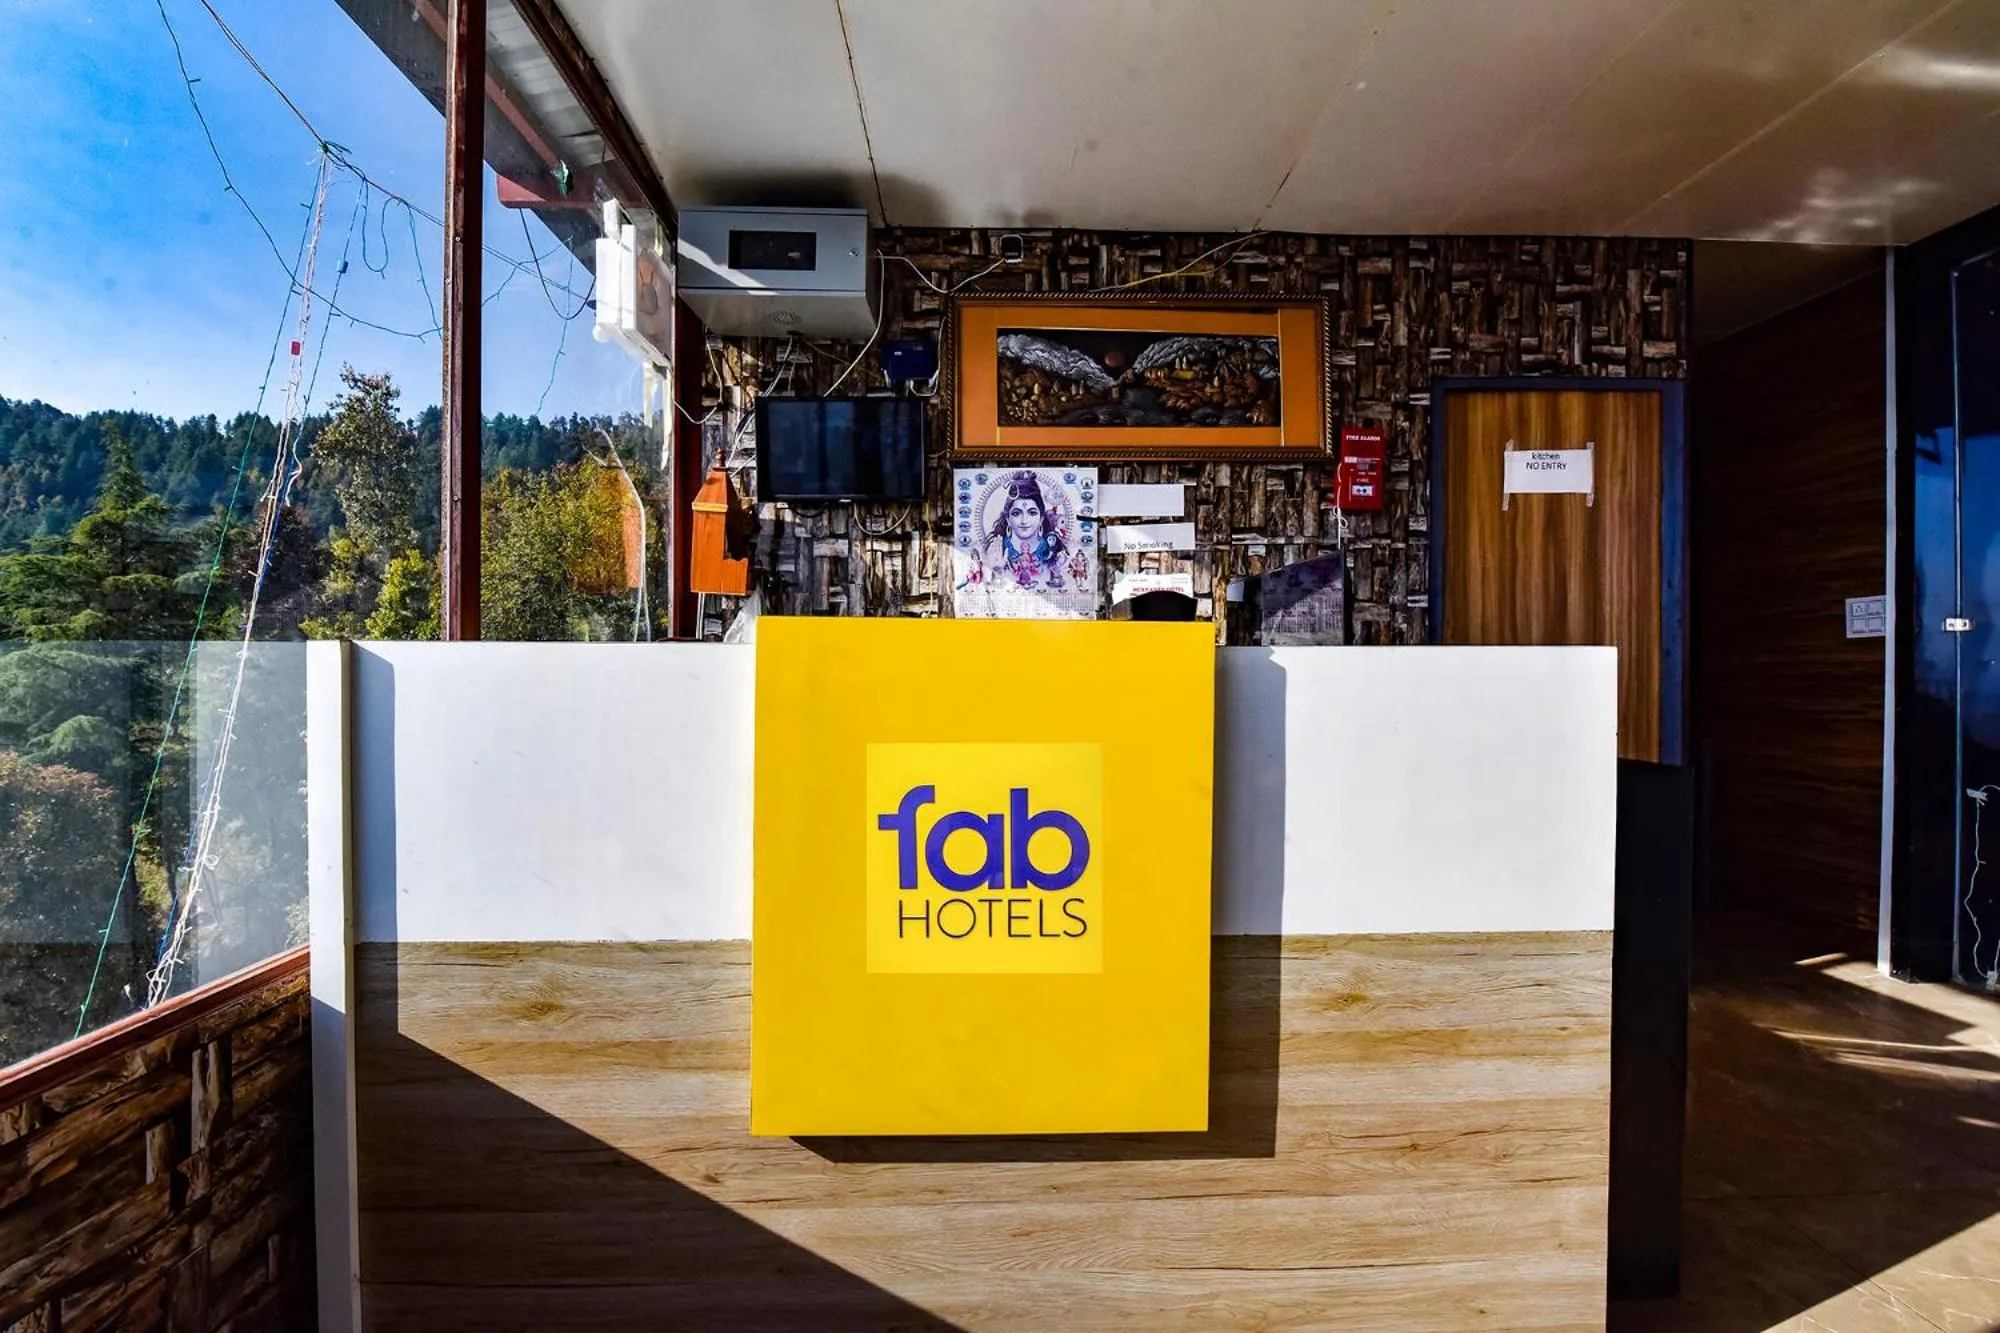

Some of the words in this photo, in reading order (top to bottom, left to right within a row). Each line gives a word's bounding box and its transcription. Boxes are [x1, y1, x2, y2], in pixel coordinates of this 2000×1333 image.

[1531, 452, 1561, 460] kitchen
[1526, 462, 1540, 470] NO
[1541, 462, 1568, 470] ENTRY
[1138, 541, 1174, 550] Smoking
[877, 784, 1091, 892] fab
[898, 897, 1088, 939] HOTELS
